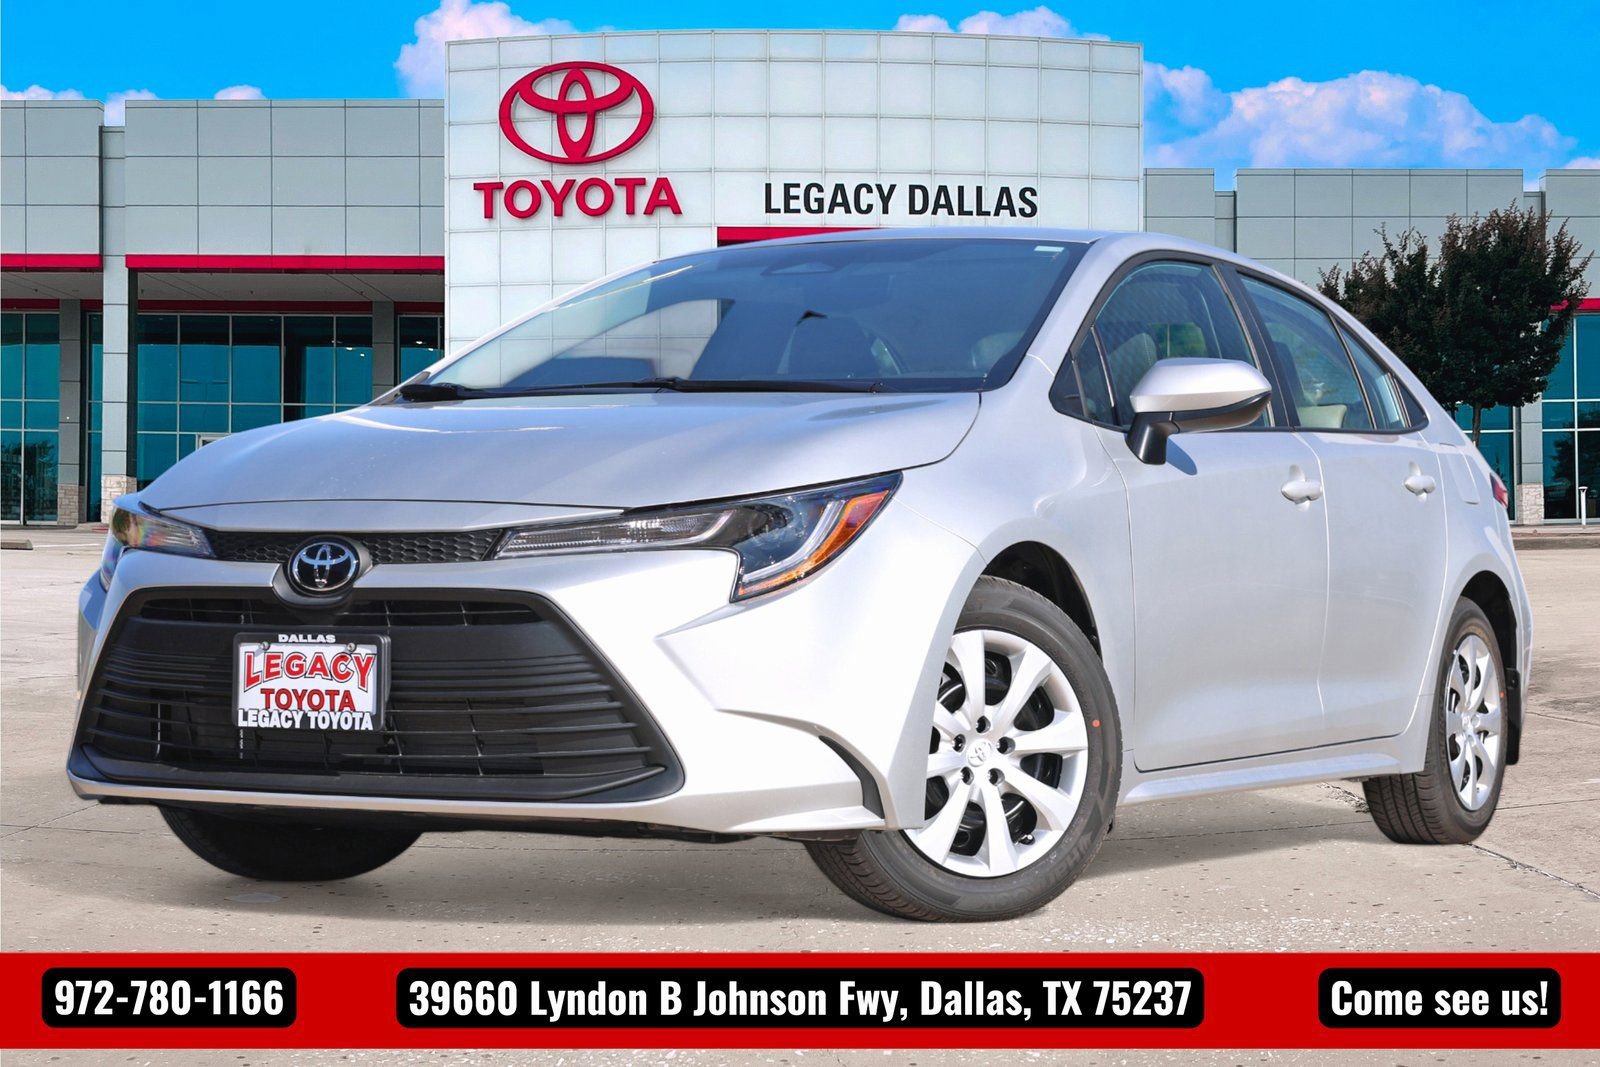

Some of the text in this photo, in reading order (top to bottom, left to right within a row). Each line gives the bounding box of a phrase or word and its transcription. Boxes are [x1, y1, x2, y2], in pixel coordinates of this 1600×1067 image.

[474, 177, 682, 219] TOYOTA
[765, 183, 1037, 217] LEGACY DALLAS
[278, 634, 336, 643] DALLAS
[244, 652, 376, 692] LEGACY
[261, 688, 356, 712] TOYOTA
[237, 708, 373, 730] LEGACY TOYOTA
